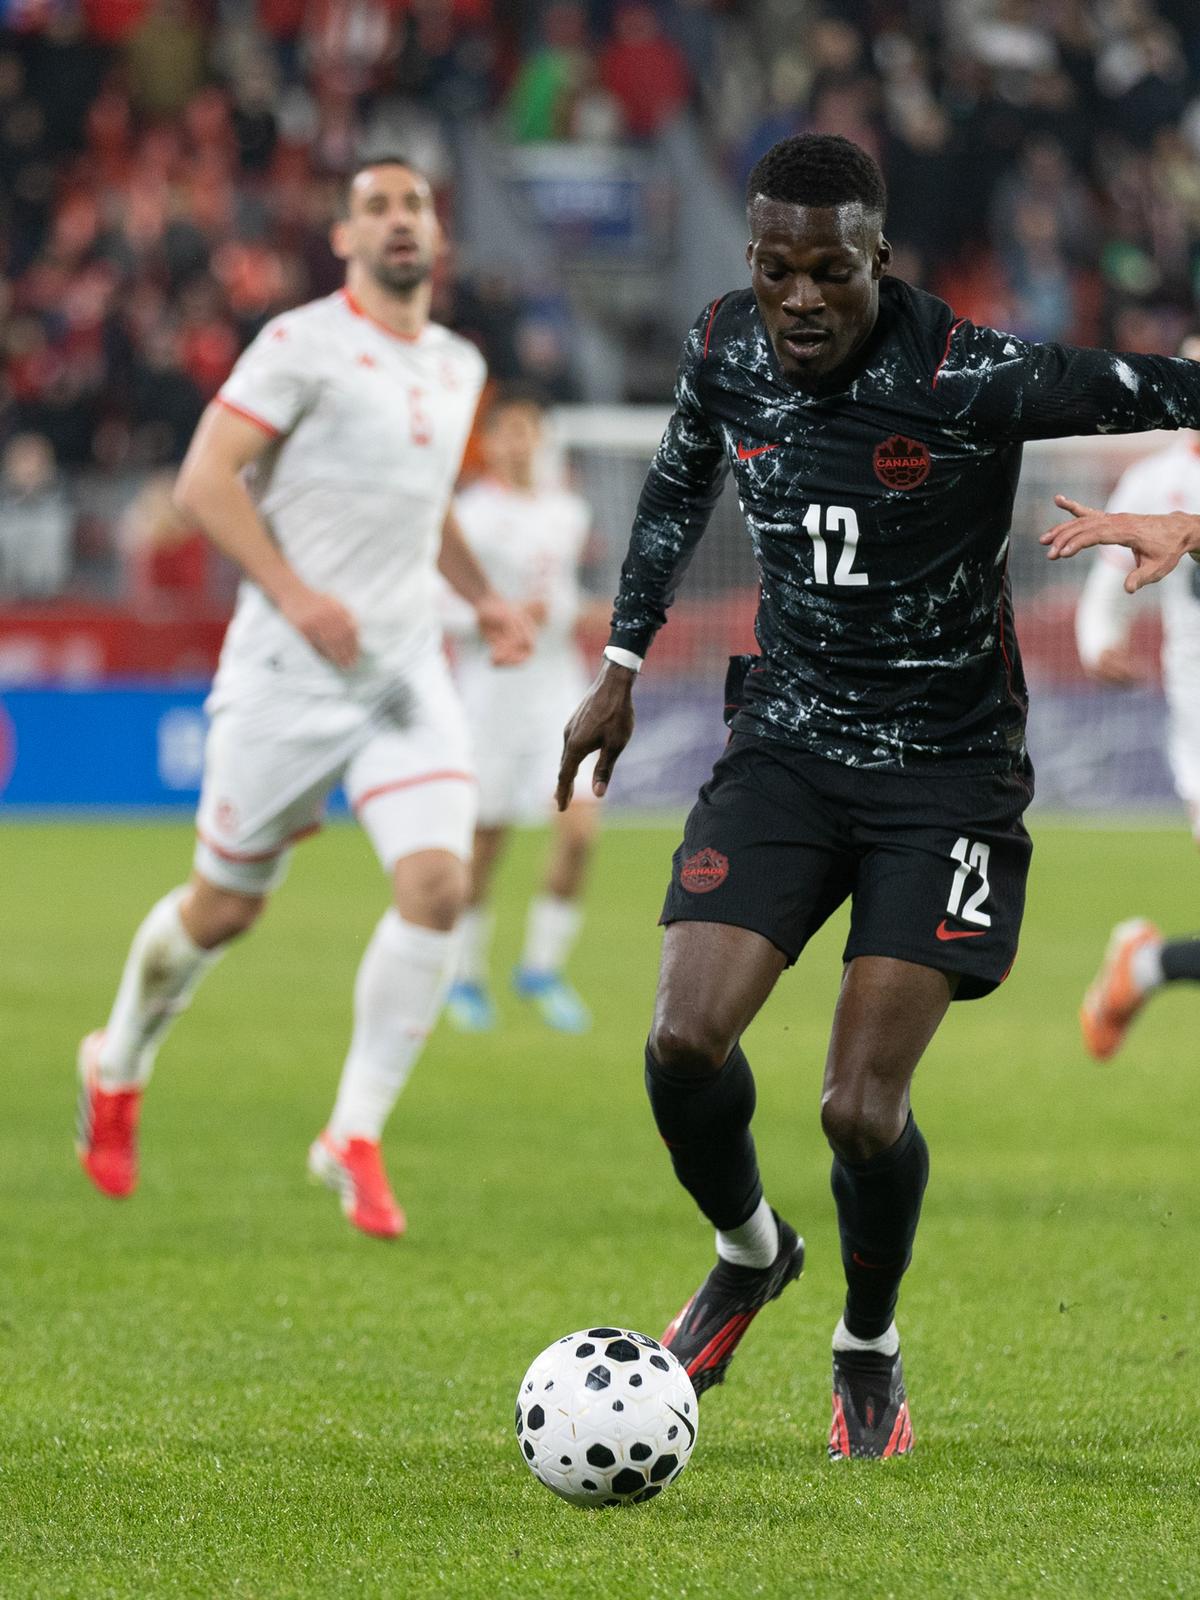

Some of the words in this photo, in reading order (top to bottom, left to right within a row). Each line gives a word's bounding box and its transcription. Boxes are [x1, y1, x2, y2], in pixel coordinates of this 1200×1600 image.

[876, 458, 927, 468] CANADA
[802, 504, 869, 586] 12
[947, 837, 991, 927] 12
